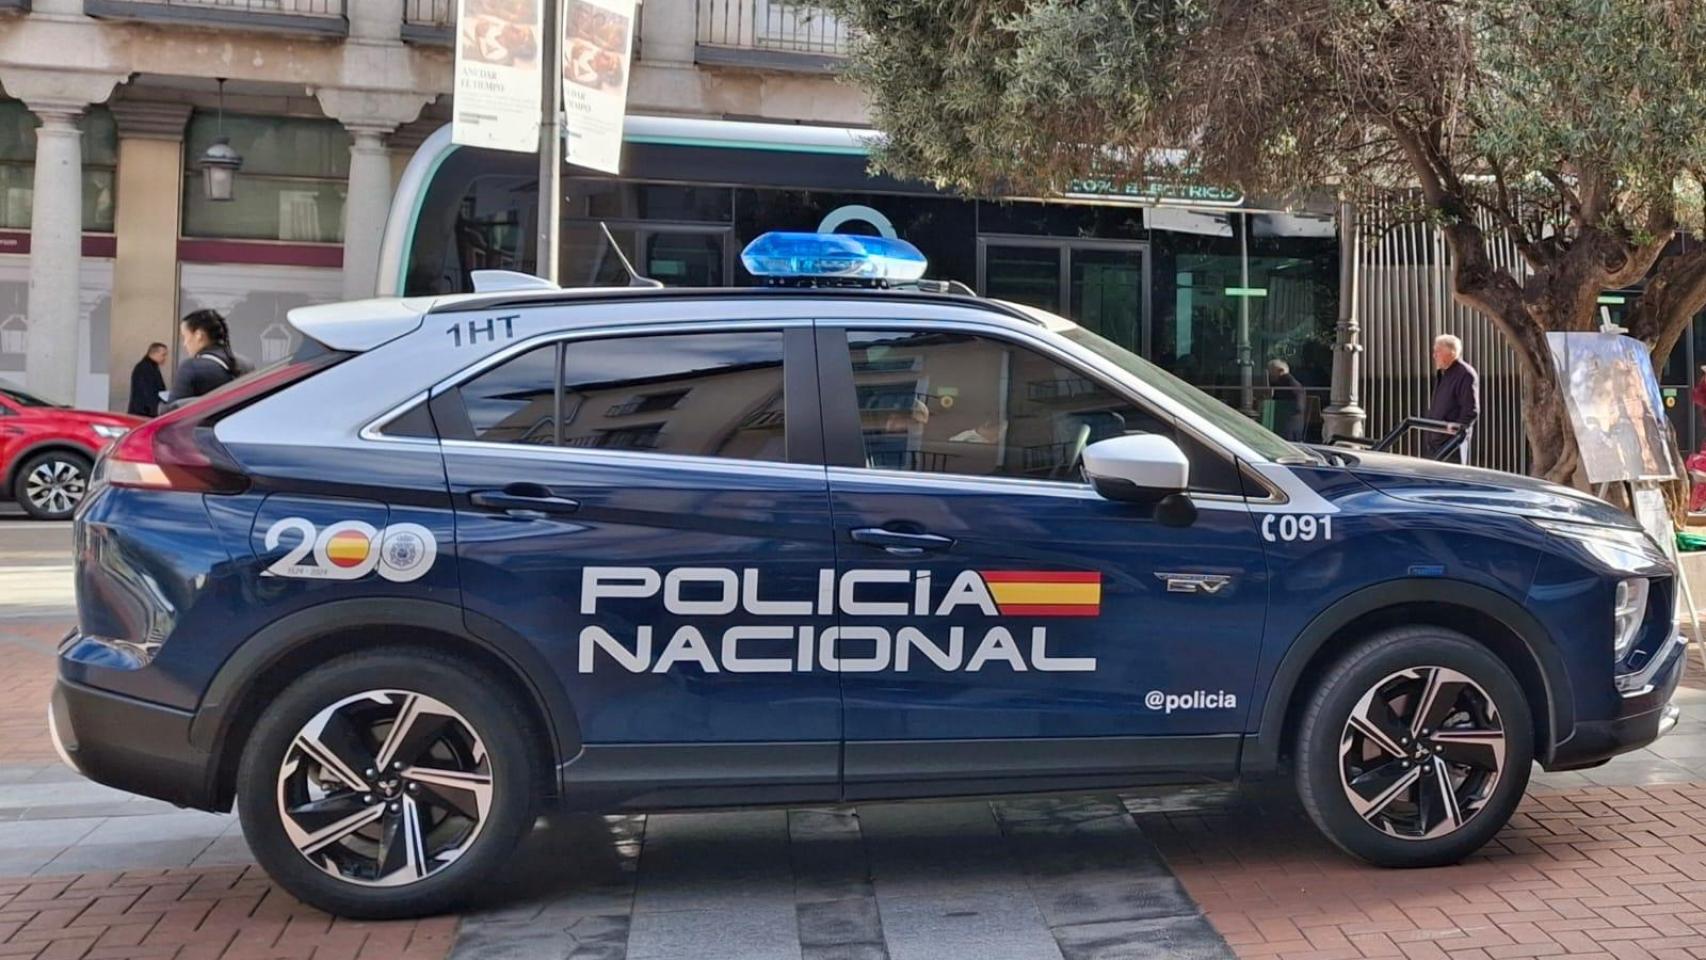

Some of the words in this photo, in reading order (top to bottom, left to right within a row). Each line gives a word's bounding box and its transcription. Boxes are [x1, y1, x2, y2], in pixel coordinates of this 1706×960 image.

[472, 80, 505, 92] TIEMPO
[446, 315, 520, 347] 1HT
[1279, 514, 1332, 541] 091
[259, 517, 437, 582] 200
[578, 625, 1097, 673] NACIONAL
[1144, 690, 1237, 714] @policia
